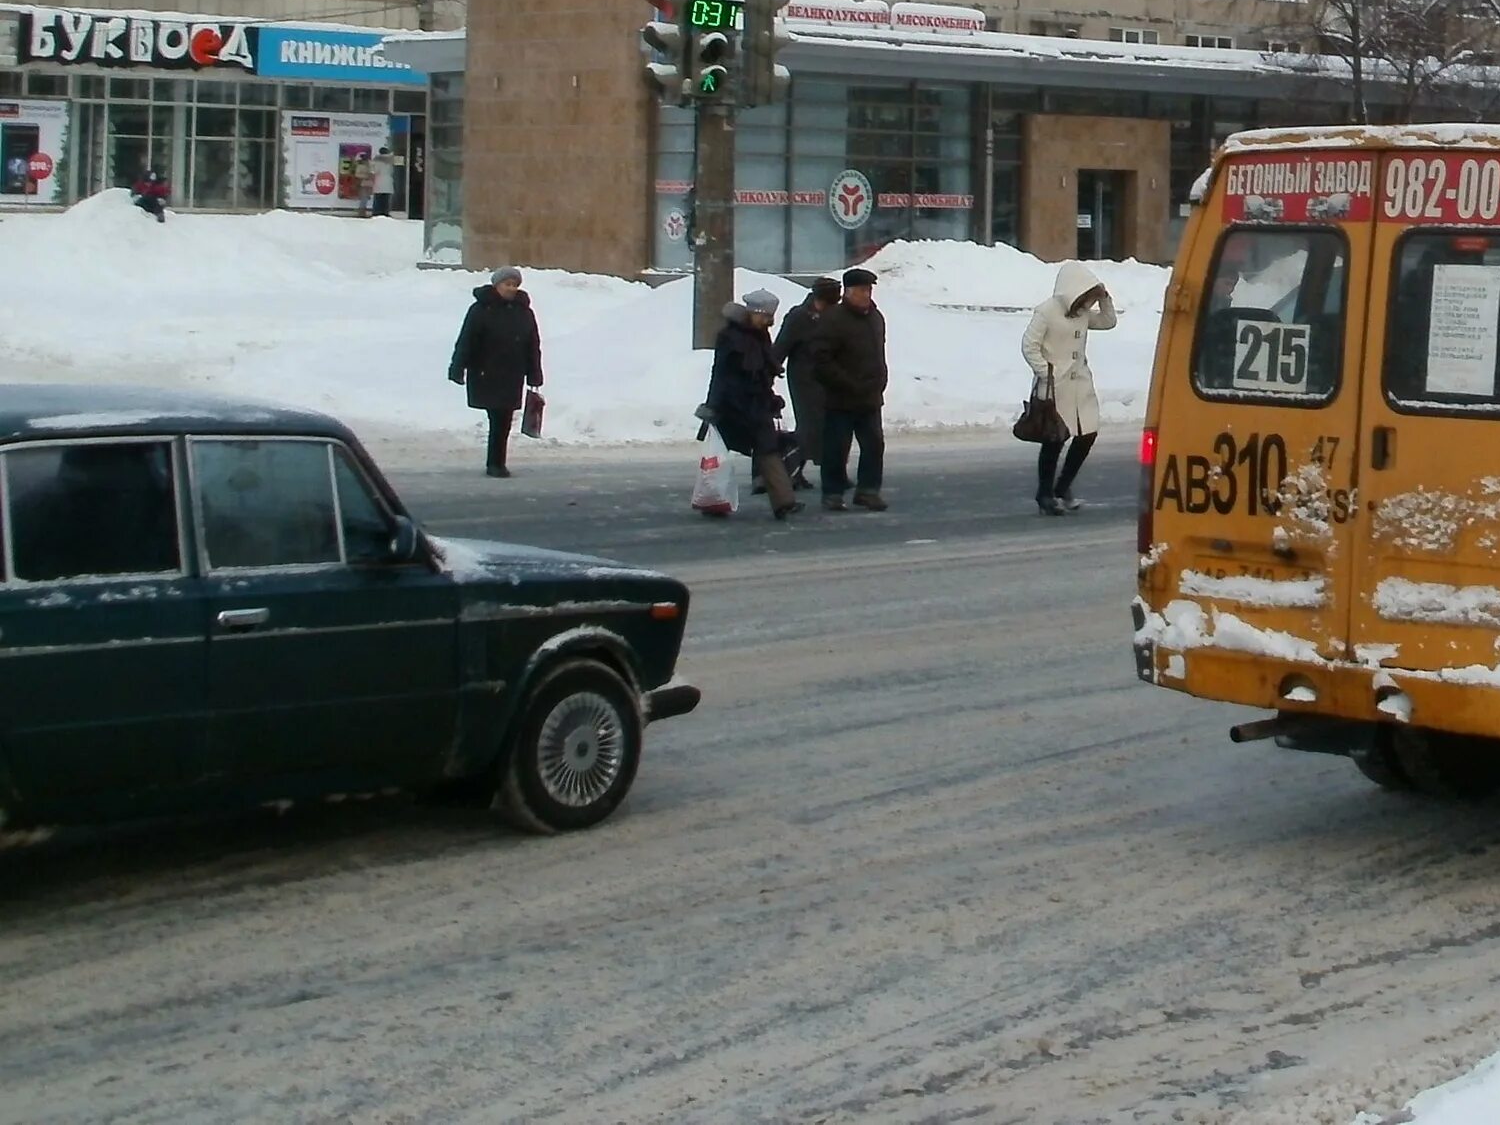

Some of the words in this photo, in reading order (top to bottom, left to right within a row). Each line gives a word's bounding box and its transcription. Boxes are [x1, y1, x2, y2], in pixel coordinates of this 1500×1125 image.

[787, 5, 890, 24] ВЕЛИКОЛУКСКИЙ
[896, 13, 985, 31] МЯСОКОМБИНАТ
[280, 40, 411, 70] КНИЖН
[1227, 156, 1311, 195] БЕТОННЫЙ
[1315, 161, 1372, 197] ЗАВОД
[1237, 324, 1306, 384] 215
